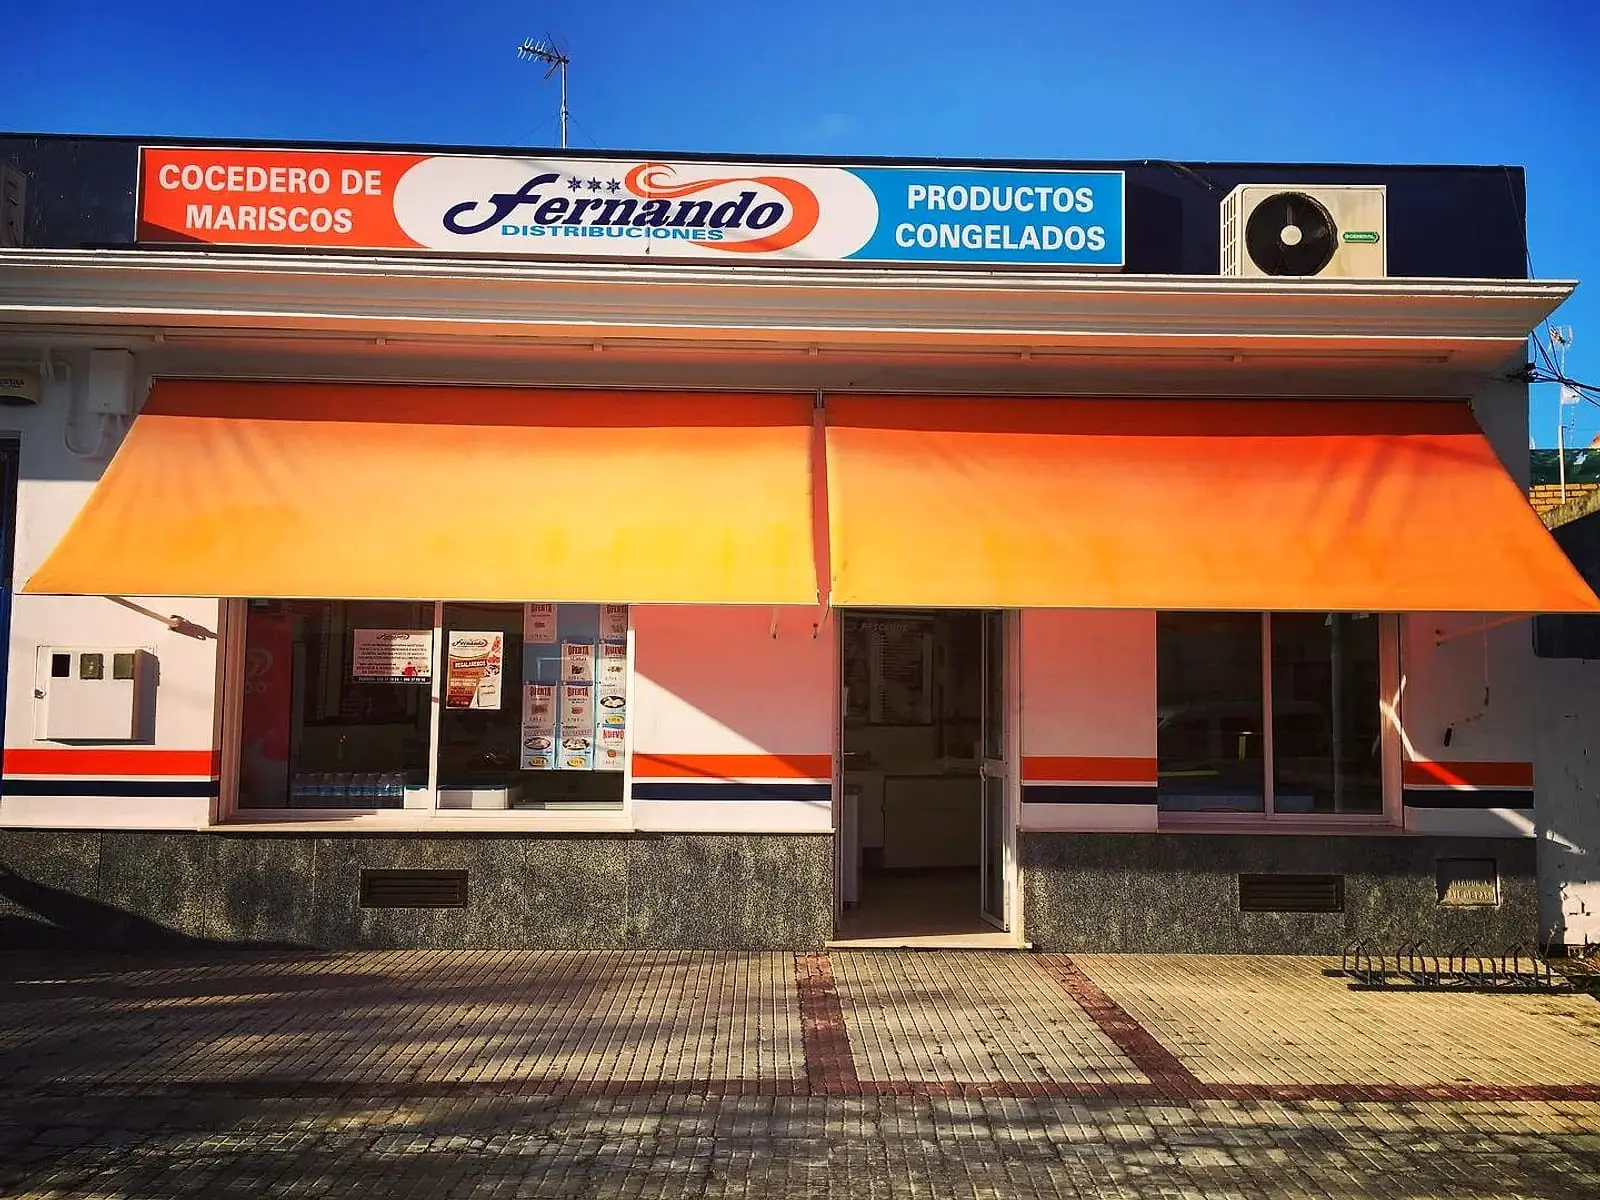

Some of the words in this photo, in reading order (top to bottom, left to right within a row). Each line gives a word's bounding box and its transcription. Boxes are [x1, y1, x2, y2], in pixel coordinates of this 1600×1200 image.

[159, 164, 330, 194] COCEDERO
[341, 168, 382, 195] DE
[443, 173, 785, 235] Fernando
[907, 184, 1094, 213] PRODUCTOS
[185, 204, 352, 234] MARISCOS
[501, 224, 724, 241] DISTRIBUCIONES
[895, 223, 1106, 251] CONGELADOS
